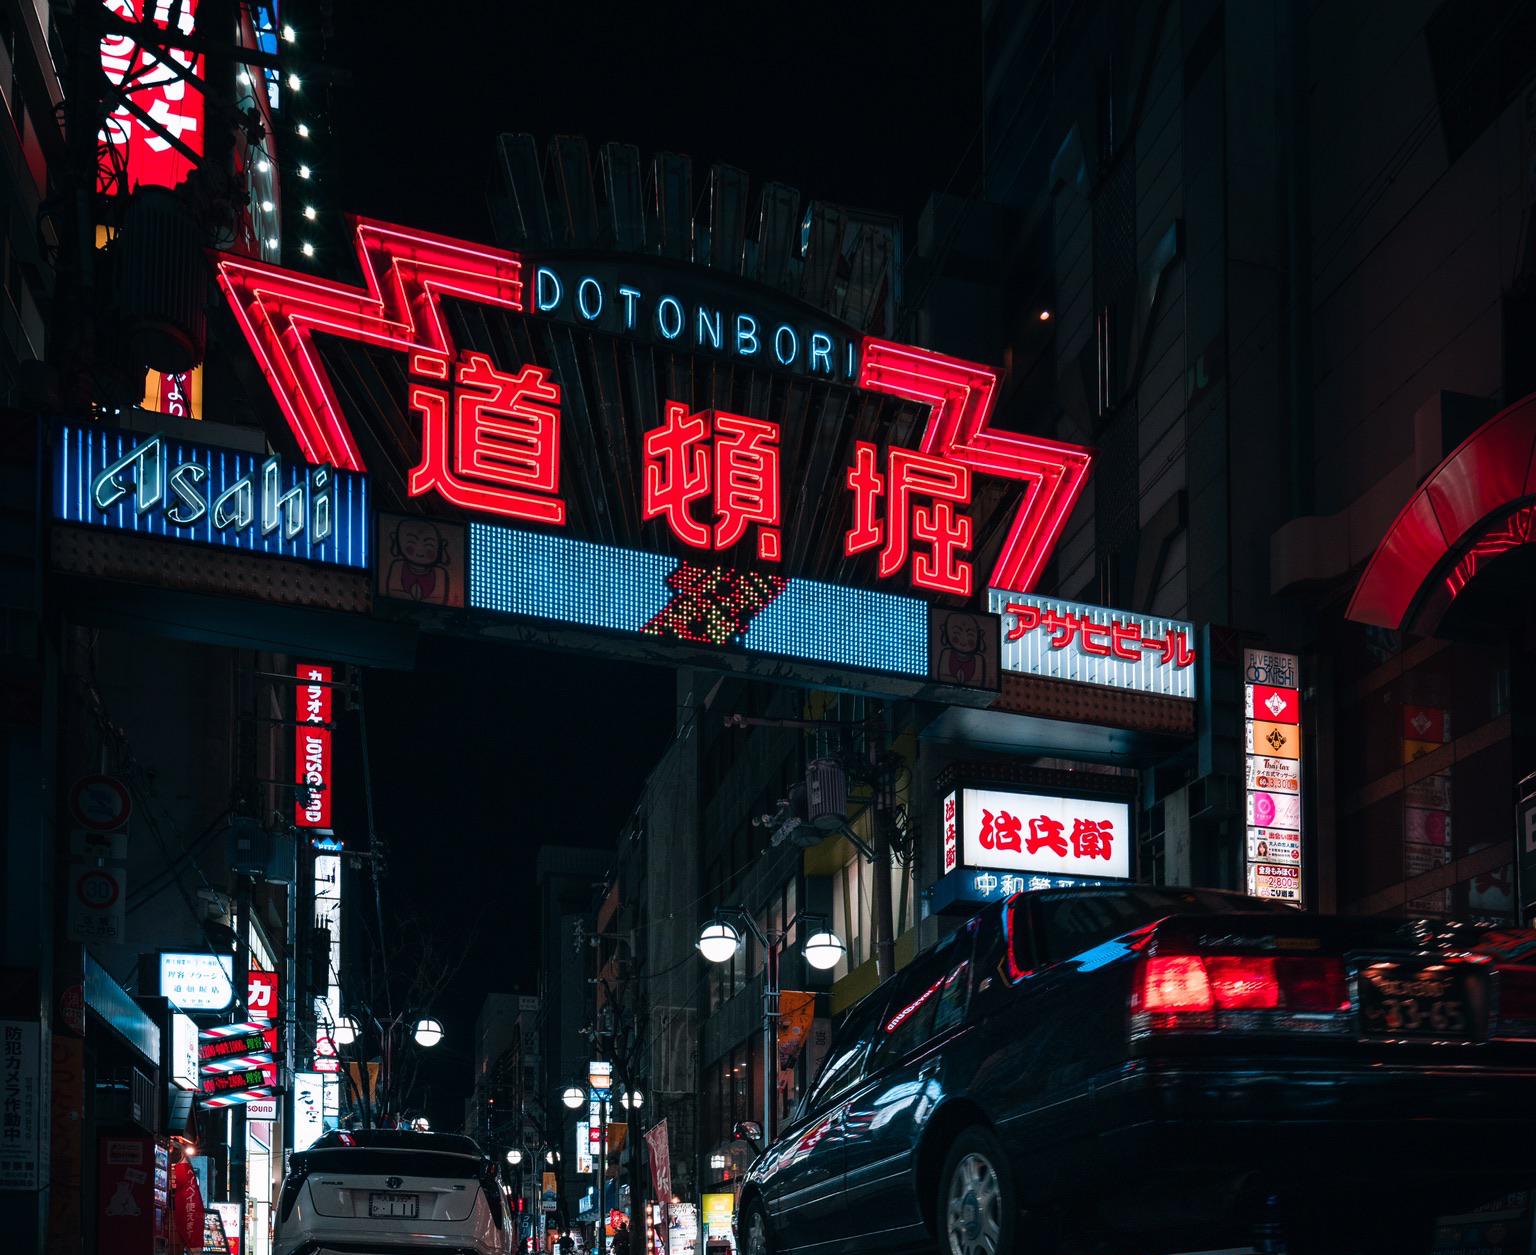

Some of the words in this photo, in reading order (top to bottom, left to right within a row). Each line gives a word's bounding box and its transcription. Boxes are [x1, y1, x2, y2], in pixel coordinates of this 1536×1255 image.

[537, 268, 856, 378] DOTONBORI
[91, 432, 332, 544] Asahi
[408, 349, 974, 597] 道頓堀
[1005, 602, 1196, 668] アサヒビール
[1250, 654, 1293, 669] RIVERSIDE
[979, 809, 1114, 860] 治兵衛
[5, 1026, 23, 1142] 防犯カメラ作動中
